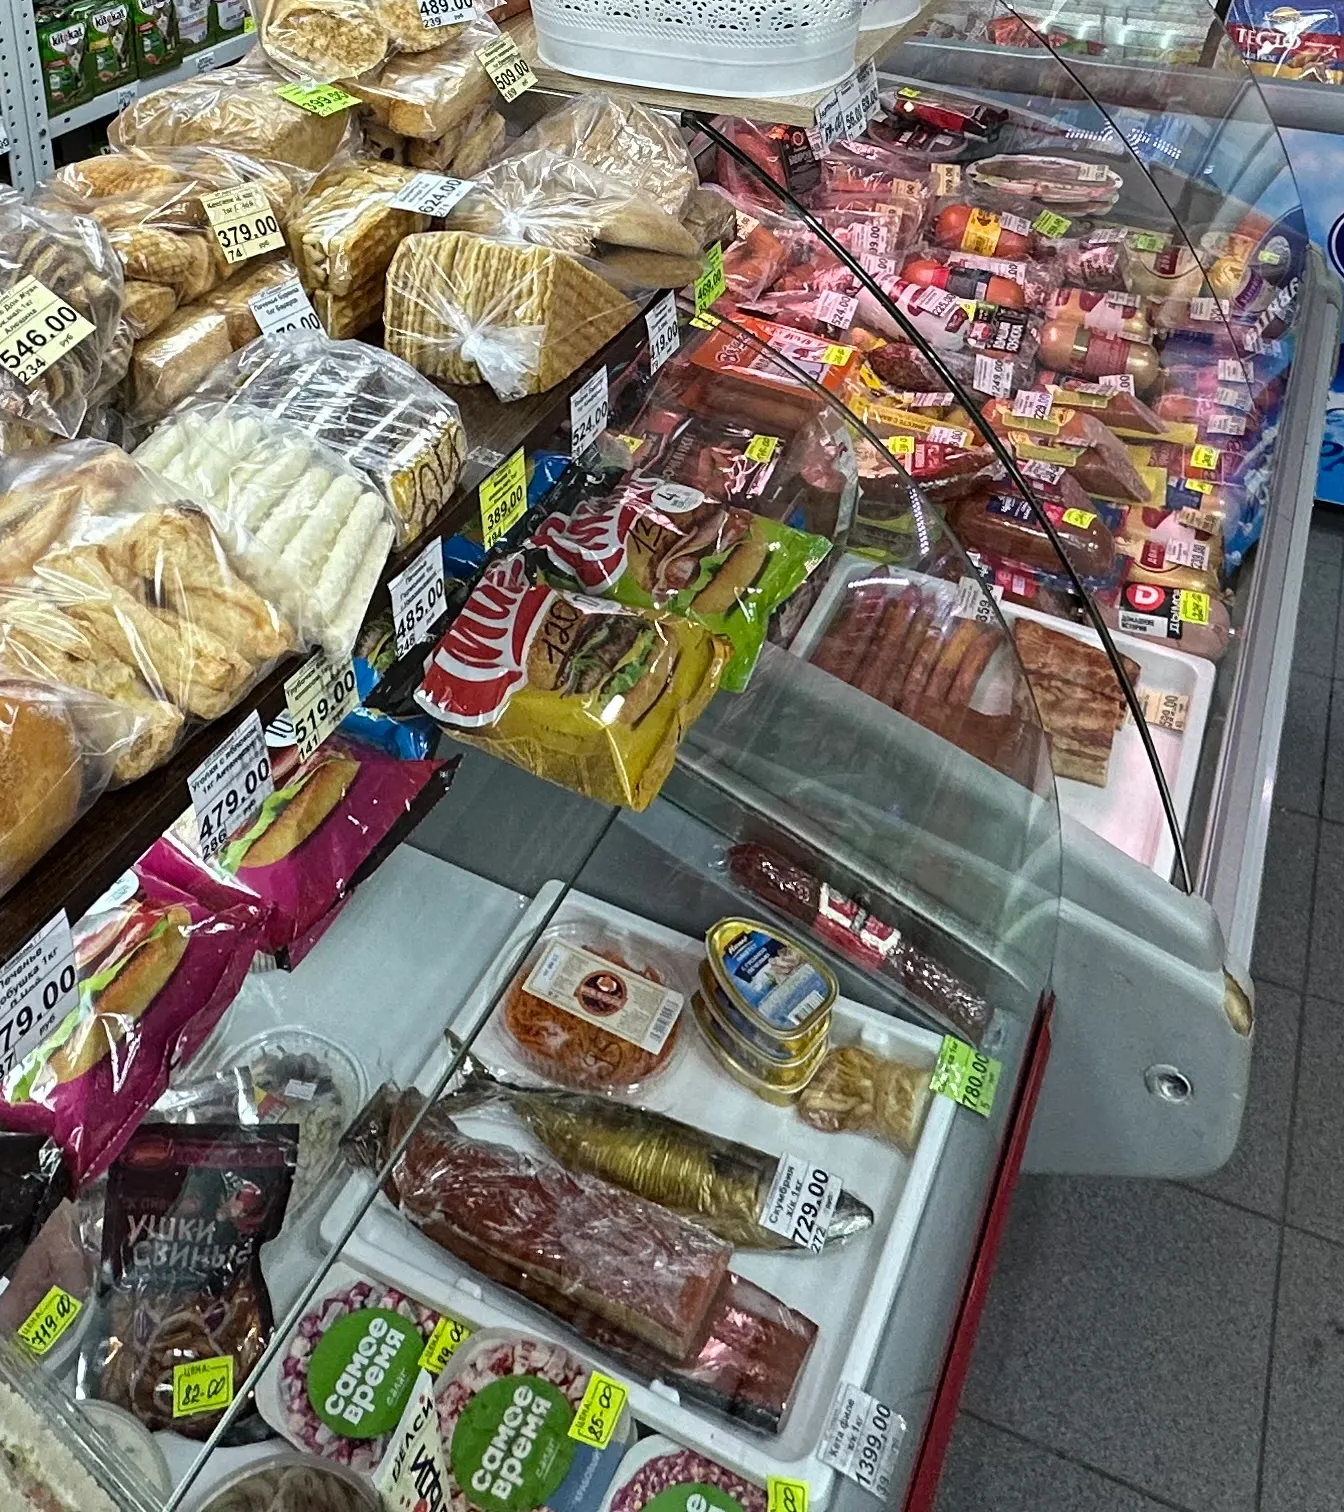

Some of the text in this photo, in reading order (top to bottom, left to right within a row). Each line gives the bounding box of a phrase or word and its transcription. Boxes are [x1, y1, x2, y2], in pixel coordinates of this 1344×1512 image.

[423, 16, 442, 29] 239
[494, 59, 529, 91] 509.00
[217, 215, 278, 249] 379.00
[227, 248, 244, 262] 74
[17, 357, 47, 383] 234
[571, 400, 609, 450] 524.00
[487, 484, 524, 533] 389.00
[396, 577, 444, 639] 485.00
[295, 670, 356, 744] 519.00
[297, 734, 319, 761] 141
[200, 756, 270, 840] 479.00
[202, 828, 227, 861] 286
[42, 946, 59, 966] 1кг
[38, 1014, 57, 1037] руб
[768, 1164, 795, 1225] Скумбрия
[792, 1168, 829, 1246] 729.00
[126, 1215, 216, 1245] УШКИ
[811, 1226, 826, 1255] 272
[324, 1317, 389, 1417] самое
[342, 1327, 407, 1425] время
[471, 1384, 534, 1492] самое
[490, 1395, 553, 1501] время
